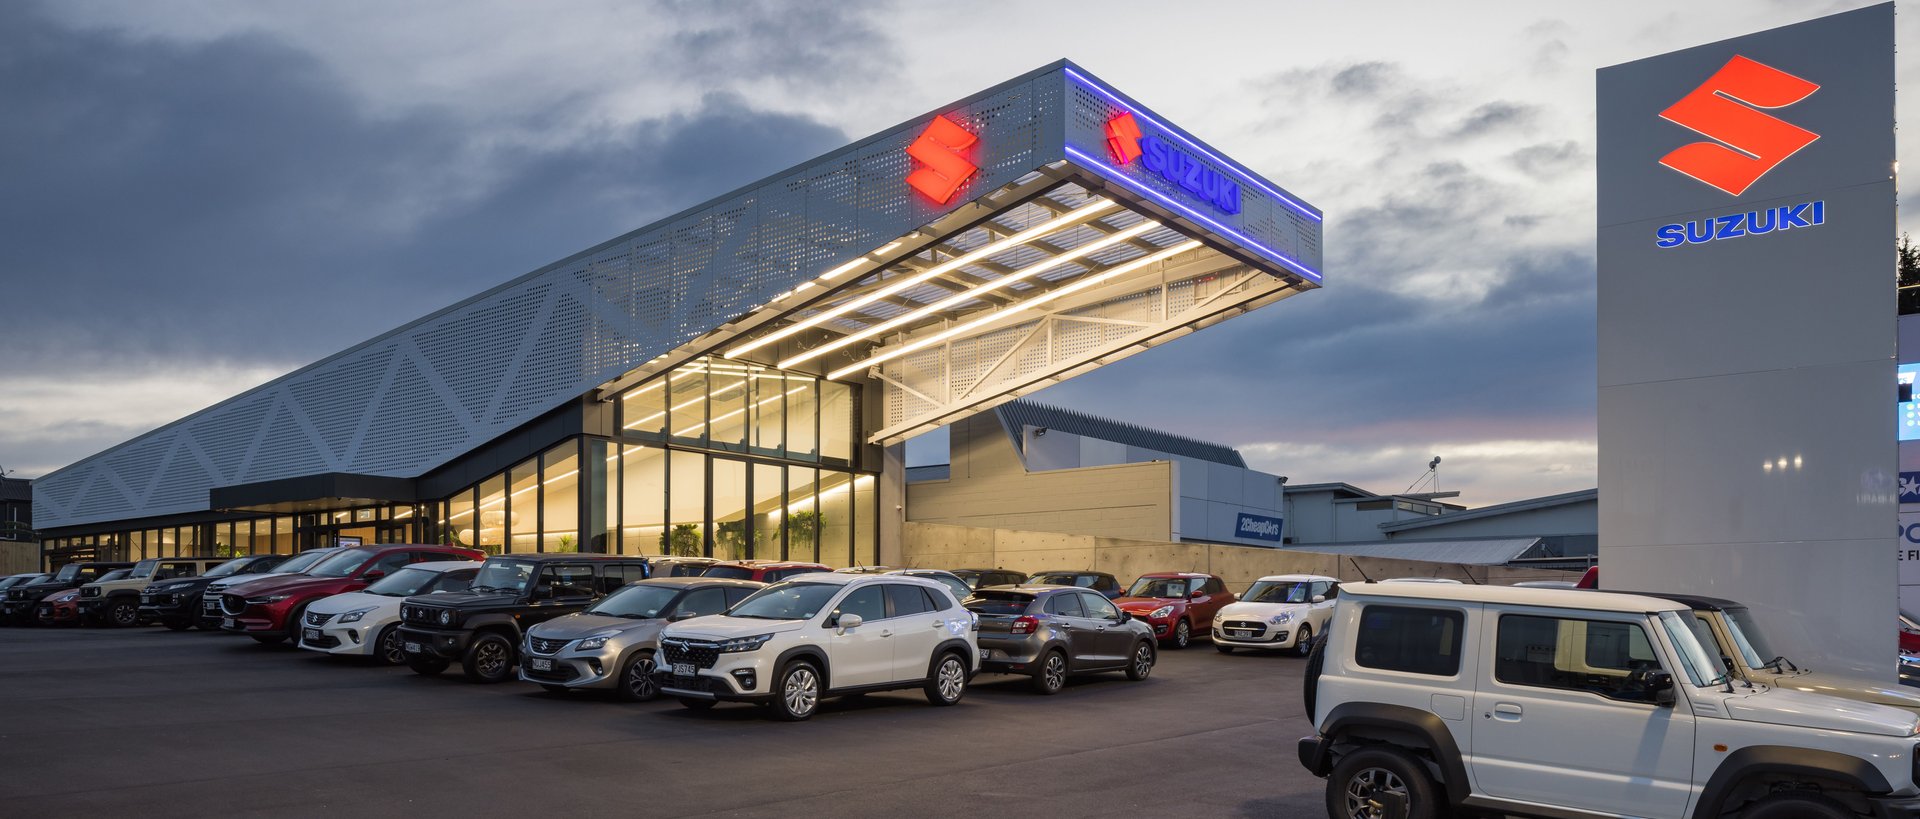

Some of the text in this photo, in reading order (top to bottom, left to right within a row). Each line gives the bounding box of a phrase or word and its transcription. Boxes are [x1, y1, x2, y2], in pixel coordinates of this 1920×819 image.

[1142, 135, 1241, 214] SUZUKI
[1656, 200, 1825, 248] SUZUKI
[673, 664, 695, 674] PJS745
